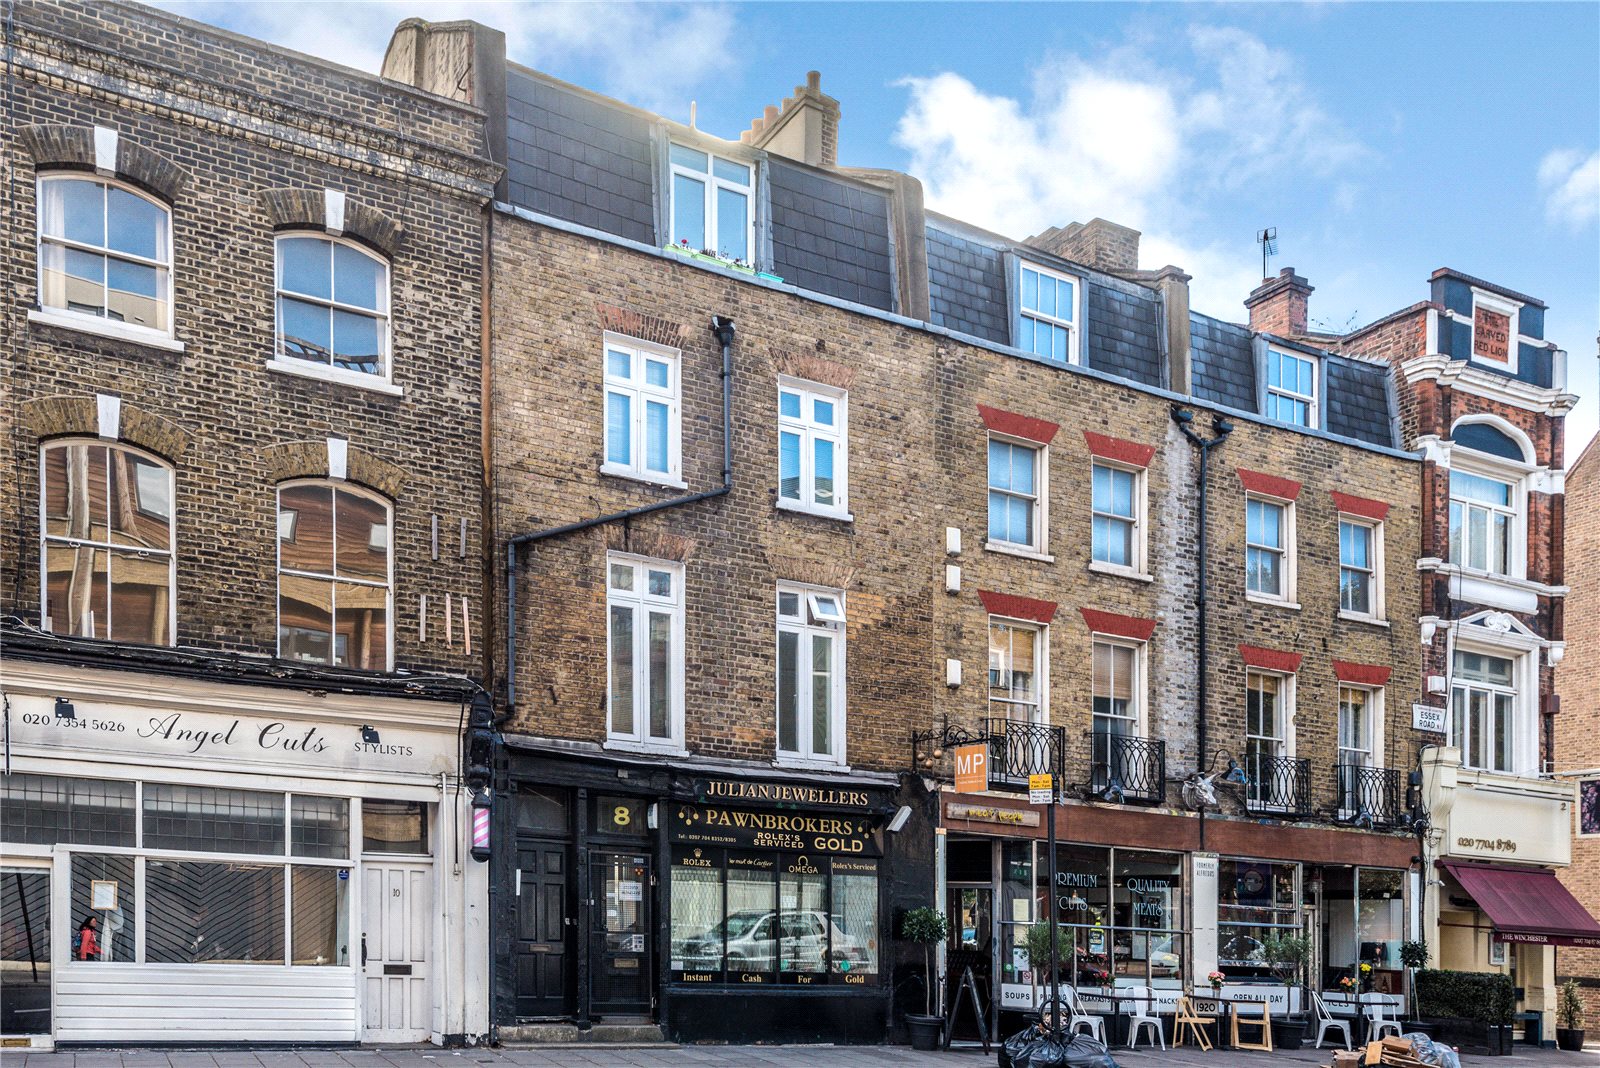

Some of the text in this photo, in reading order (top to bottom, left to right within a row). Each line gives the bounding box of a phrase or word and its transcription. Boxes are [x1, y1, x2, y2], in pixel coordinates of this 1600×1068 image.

[1476, 326, 1506, 343] CARVED
[1475, 340, 1508, 357] RED LION
[1421, 711, 1440, 721] ESSEX
[22, 713, 125, 732] 020 7354 5626
[1419, 719, 1436, 729] ROAD
[137, 713, 331, 753] Angel Cuts
[354, 742, 413, 756] STYLISTS
[957, 753, 984, 775] MP
[706, 781, 868, 806] JULIAN JEWELLERS
[1561, 802, 1567, 811] 2
[614, 806, 630, 825] 8
[705, 809, 853, 835] PAWNBROKERS
[757, 832, 800, 842] ROLEX'S
[754, 839, 804, 849] SERVICED
[814, 837, 863, 852] GOLD
[1458, 837, 1517, 853] 020 7704 8789
[683, 858, 712, 867] ROLEX
[853, 863, 877, 871] Serviced
[788, 865, 819, 874] OMEGA
[1127, 877, 1170, 895] QUALITY
[1058, 896, 1088, 911] CUTS
[1133, 901, 1164, 917] MEATS
[1514, 934, 1548, 943] WINCHESTER
[683, 973, 712, 982] Instant
[742, 973, 762, 983] Cash
[798, 975, 811, 984] For
[845, 975, 865, 984] Gold
[1004, 991, 1031, 1001] SOUPS
[1155, 997, 1178, 1005] NACKS
[1270, 995, 1284, 1003] DAY
[1196, 1003, 1216, 1012] 1920
